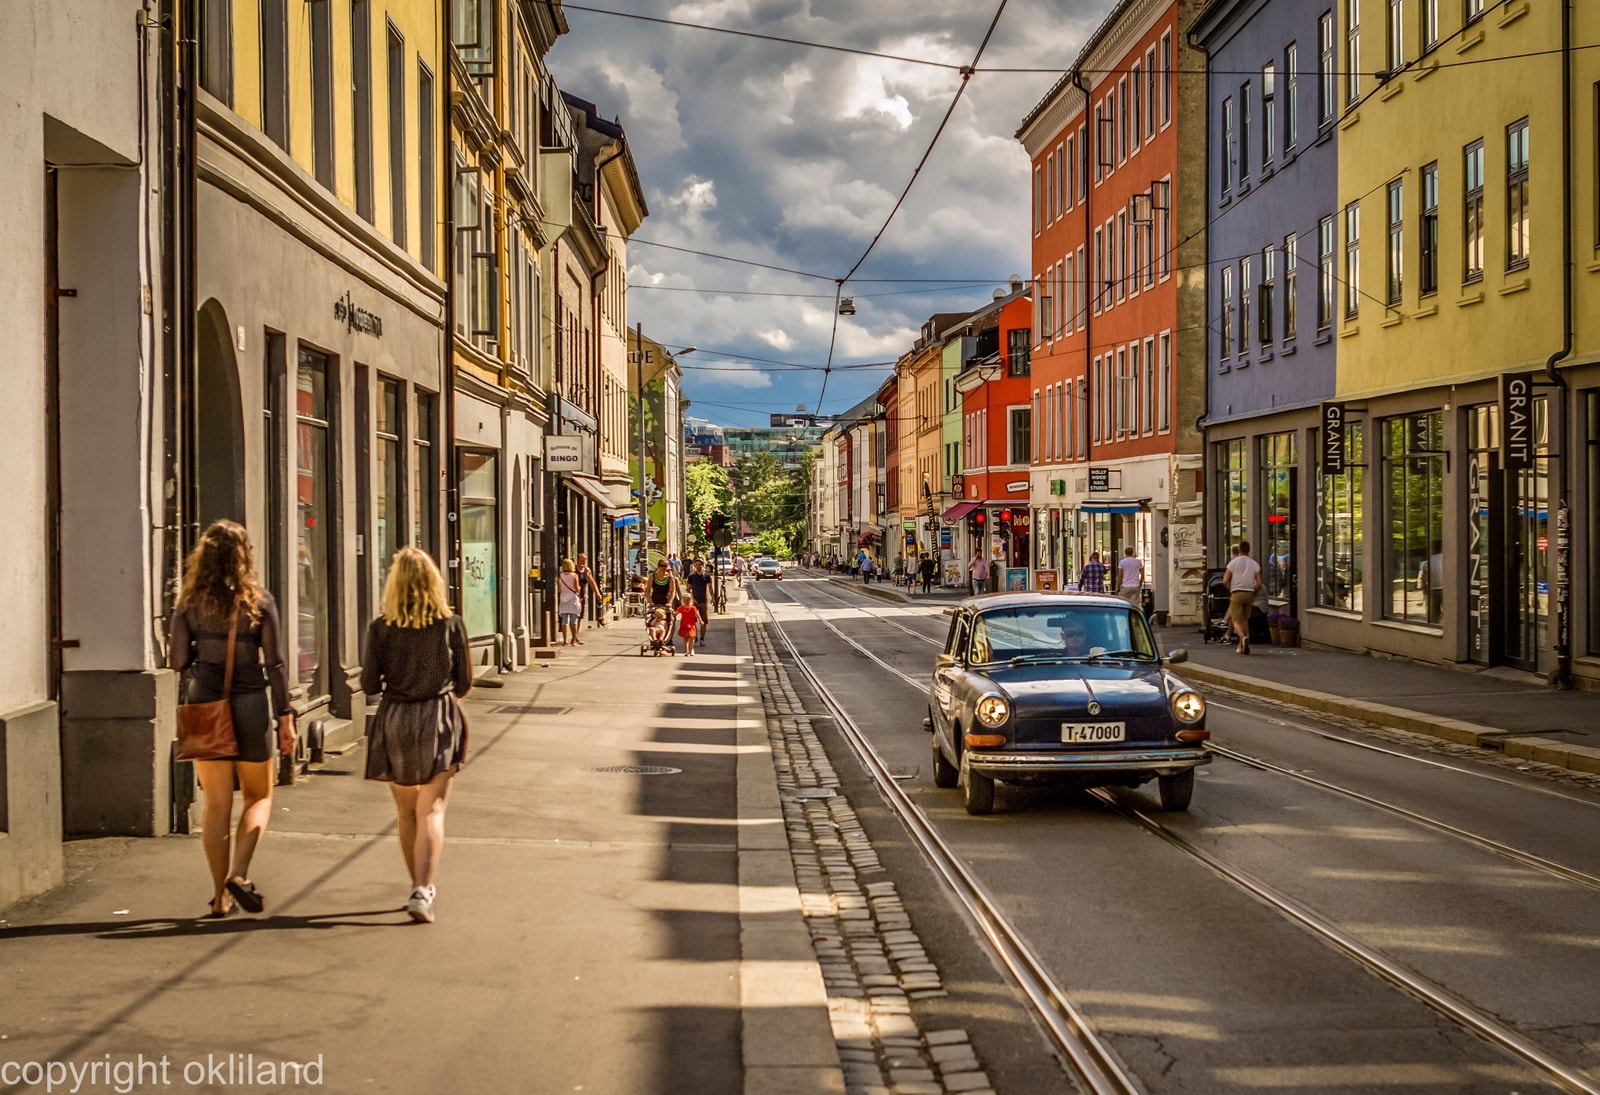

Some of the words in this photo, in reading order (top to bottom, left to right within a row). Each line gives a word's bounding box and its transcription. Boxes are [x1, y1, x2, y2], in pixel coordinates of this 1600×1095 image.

[1327, 406, 1340, 470] GRANIT
[1509, 379, 1527, 462] GRANIT
[1469, 458, 1481, 629] GRANIT
